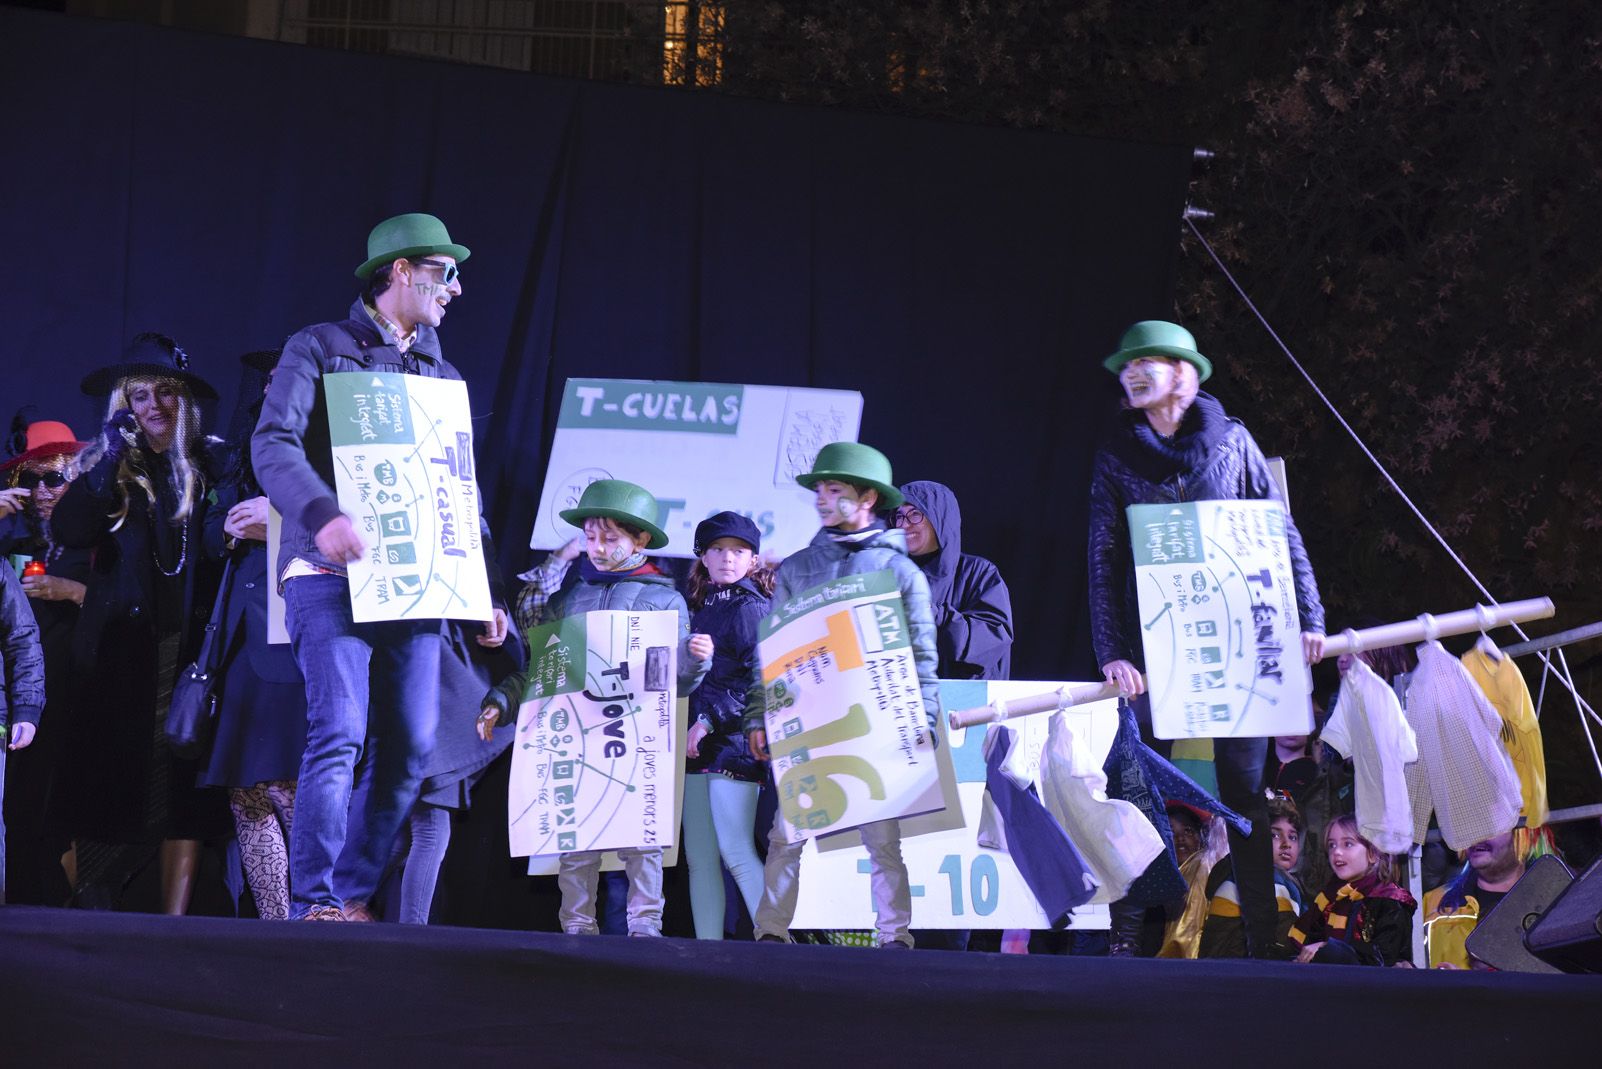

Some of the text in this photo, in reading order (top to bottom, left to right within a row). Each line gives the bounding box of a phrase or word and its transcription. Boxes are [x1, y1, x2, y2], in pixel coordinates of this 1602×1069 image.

[576, 387, 739, 425] T-CUELAS
[430, 446, 467, 558] T-casual
[363, 516, 376, 533] Bus
[375, 576, 391, 604] TRAM
[874, 604, 901, 645] ATM
[556, 646, 570, 688] Sistema
[762, 610, 865, 685] T
[583, 661, 634, 759] T-jove
[536, 763, 548, 779] Bus
[636, 747, 659, 780] joves
[769, 703, 886, 830] 16
[643, 784, 656, 826] menors
[643, 828, 656, 844] 25
